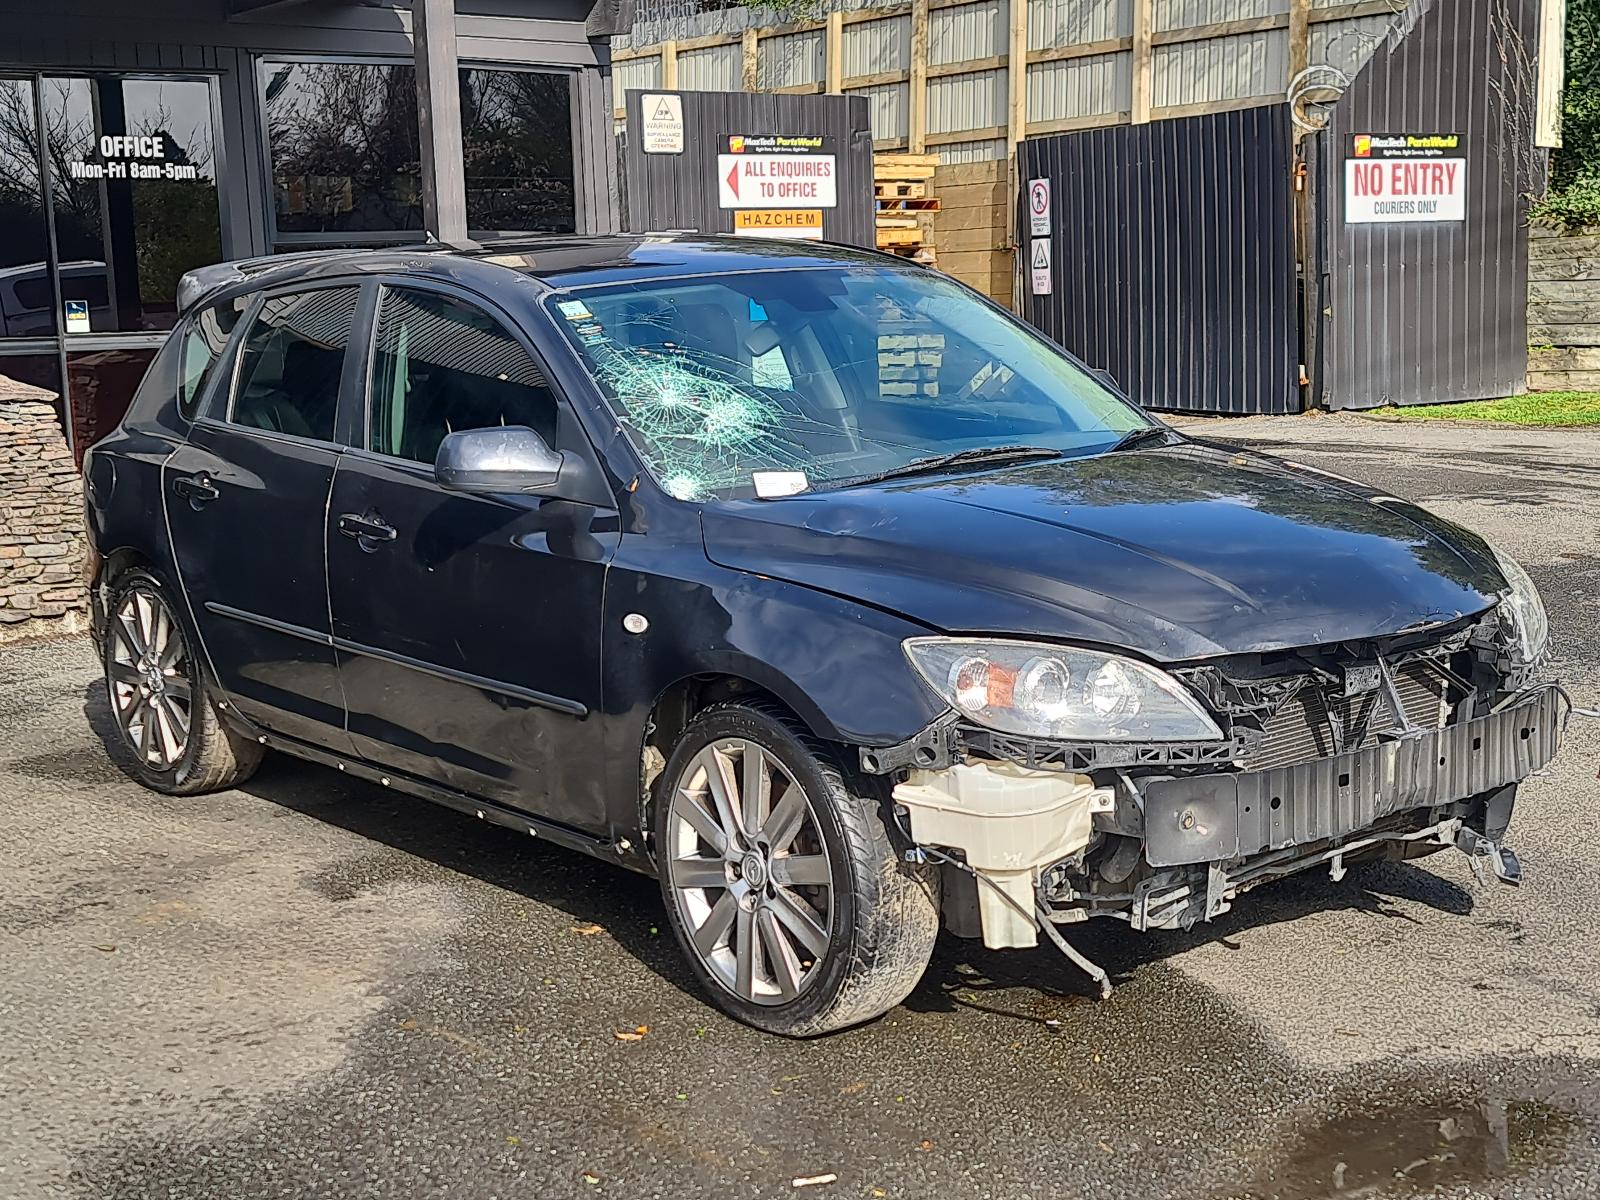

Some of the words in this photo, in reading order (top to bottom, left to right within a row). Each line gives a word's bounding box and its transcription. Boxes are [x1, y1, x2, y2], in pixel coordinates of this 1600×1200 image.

[646, 122, 682, 130] WARNING
[100, 135, 165, 158] OFFICE
[776, 136, 822, 147] PartsWorld
[1407, 135, 1458, 147] PartsWorld
[71, 161, 127, 178] Mon-Fri
[130, 162, 196, 180] 8am-5pm
[745, 162, 766, 177] ALL
[770, 162, 831, 178] ENQUIRIES
[1354, 163, 1383, 197] NO
[1391, 163, 1457, 196] ENTRY
[760, 182, 775, 198] TO
[778, 182, 817, 198] OFFICE
[1374, 201, 1415, 214] COURIERS
[1418, 200, 1438, 214] ONLY
[743, 213, 815, 225] HAZCHEM
